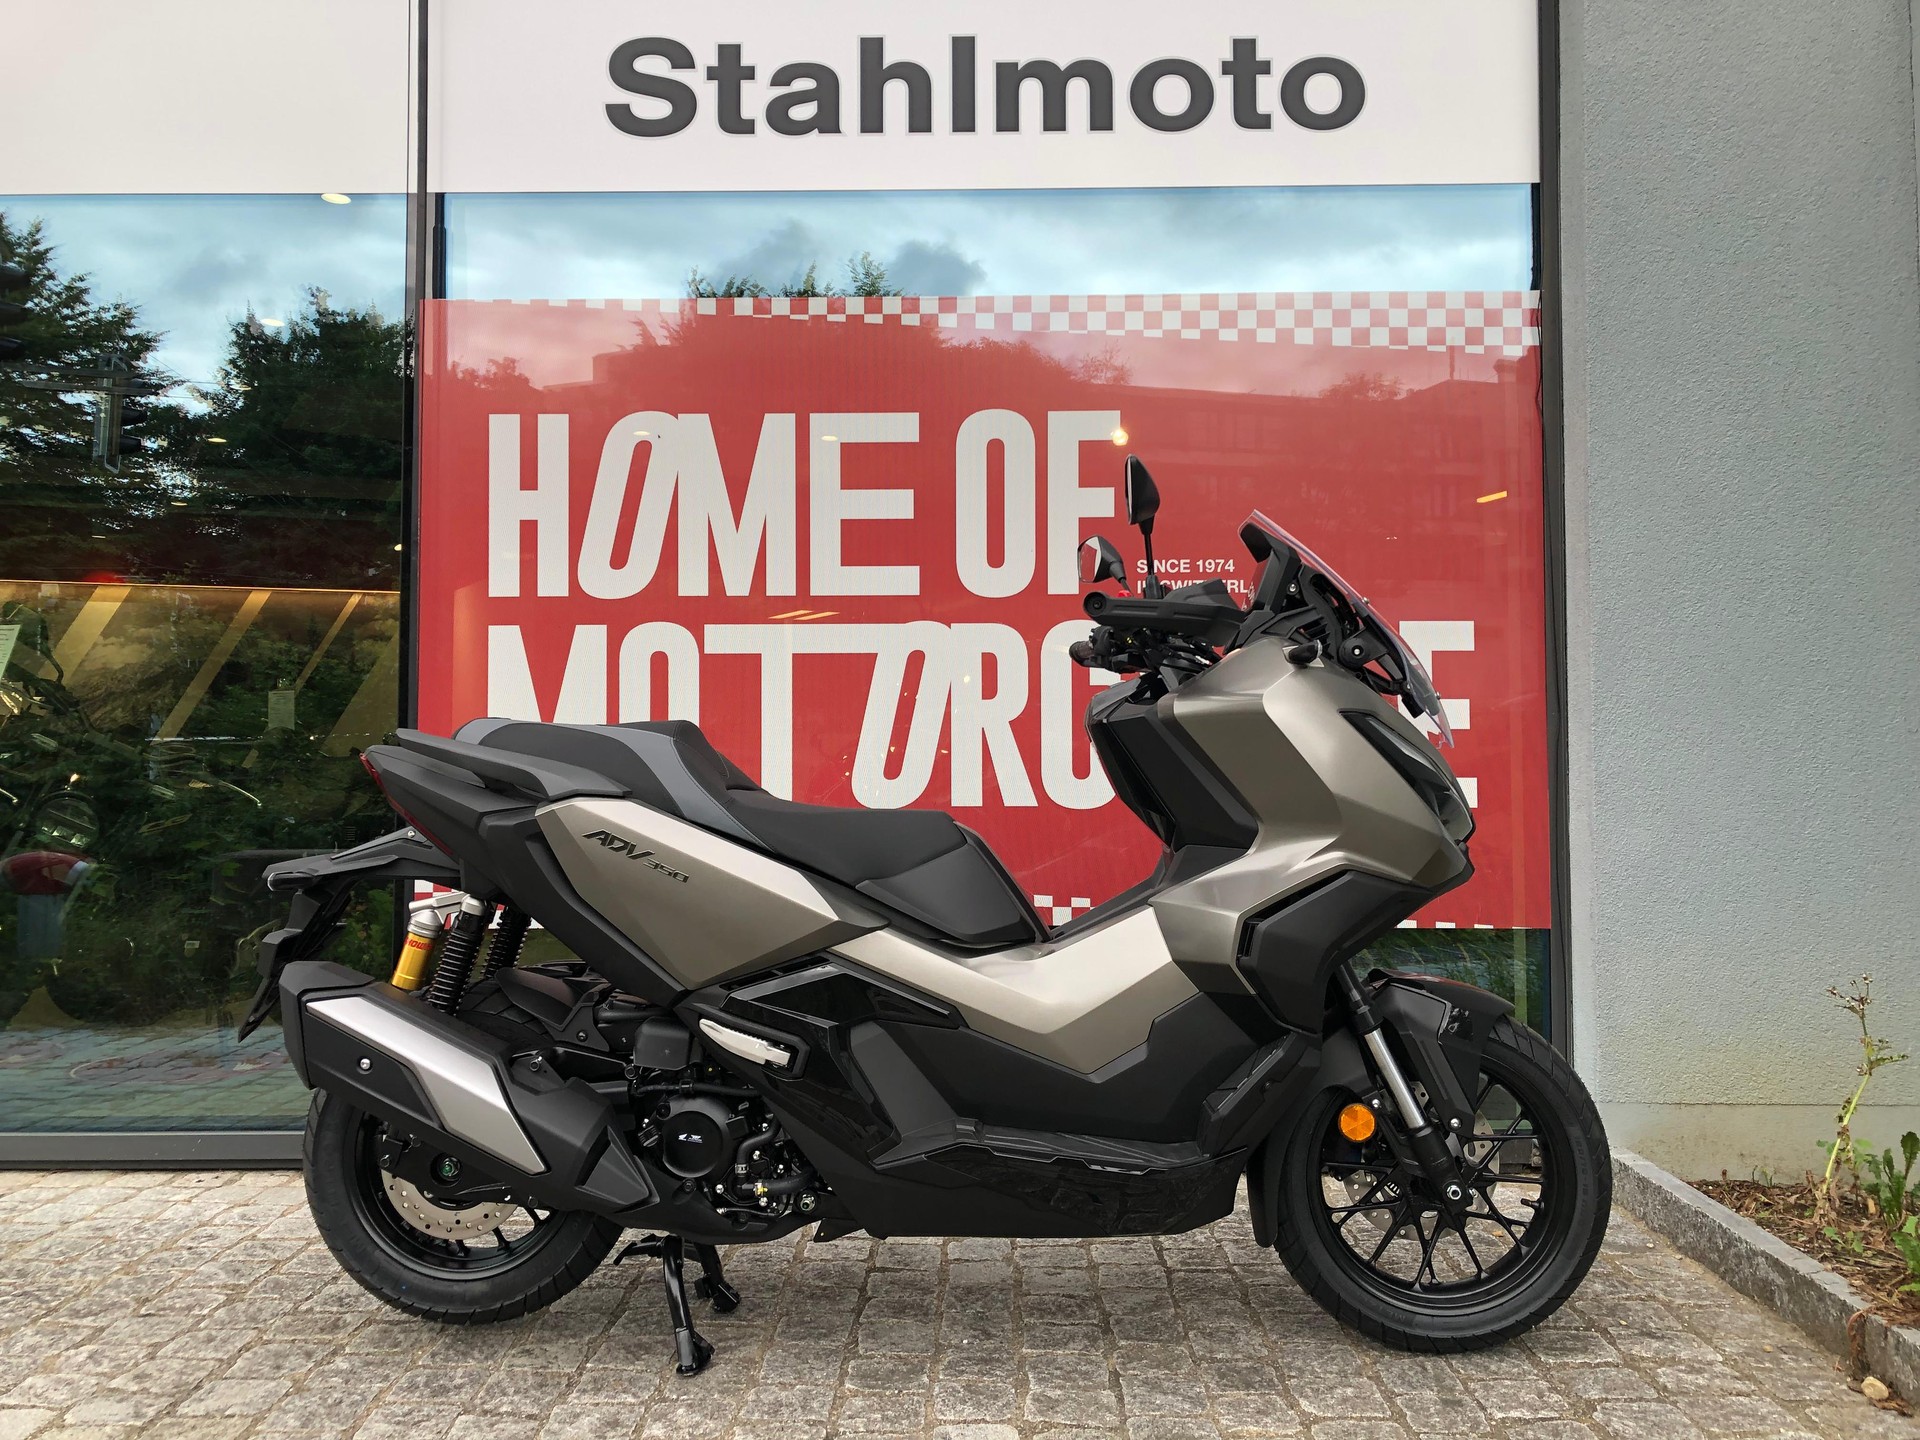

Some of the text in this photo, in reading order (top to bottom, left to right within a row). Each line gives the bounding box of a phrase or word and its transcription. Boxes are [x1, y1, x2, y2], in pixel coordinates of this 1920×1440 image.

[604, 35, 1367, 137] Stahlmoto
[488, 408, 1122, 599] HOME OF
[1136, 559, 1236, 573] SNCE 1974
